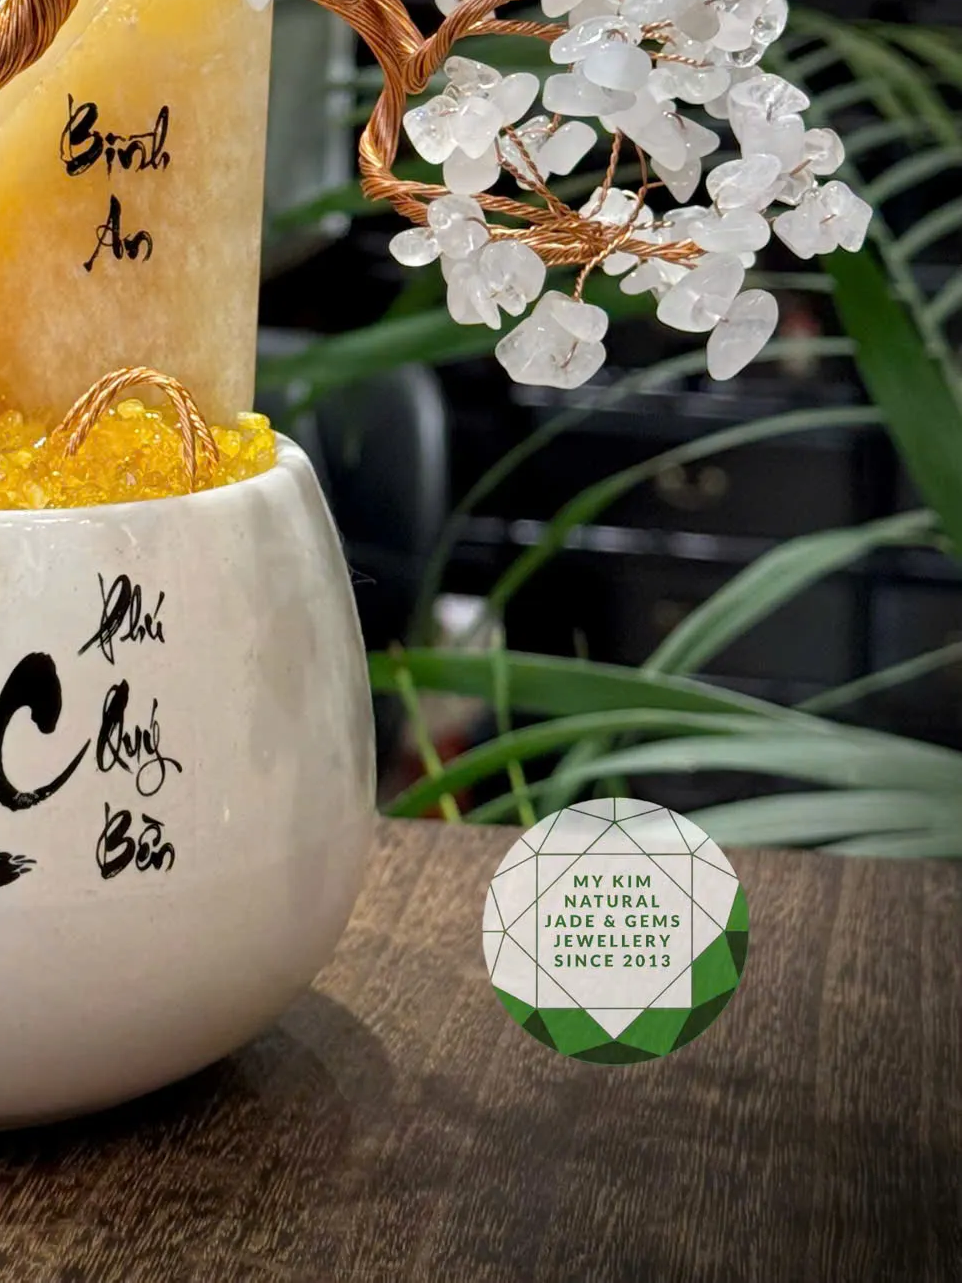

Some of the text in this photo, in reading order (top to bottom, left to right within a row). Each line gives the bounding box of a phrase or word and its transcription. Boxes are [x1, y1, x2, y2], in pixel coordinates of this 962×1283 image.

[83, 194, 153, 272] An
[78, 572, 165, 665] Phú
[96, 678, 183, 797] Quý
[96, 801, 176, 880] Bền
